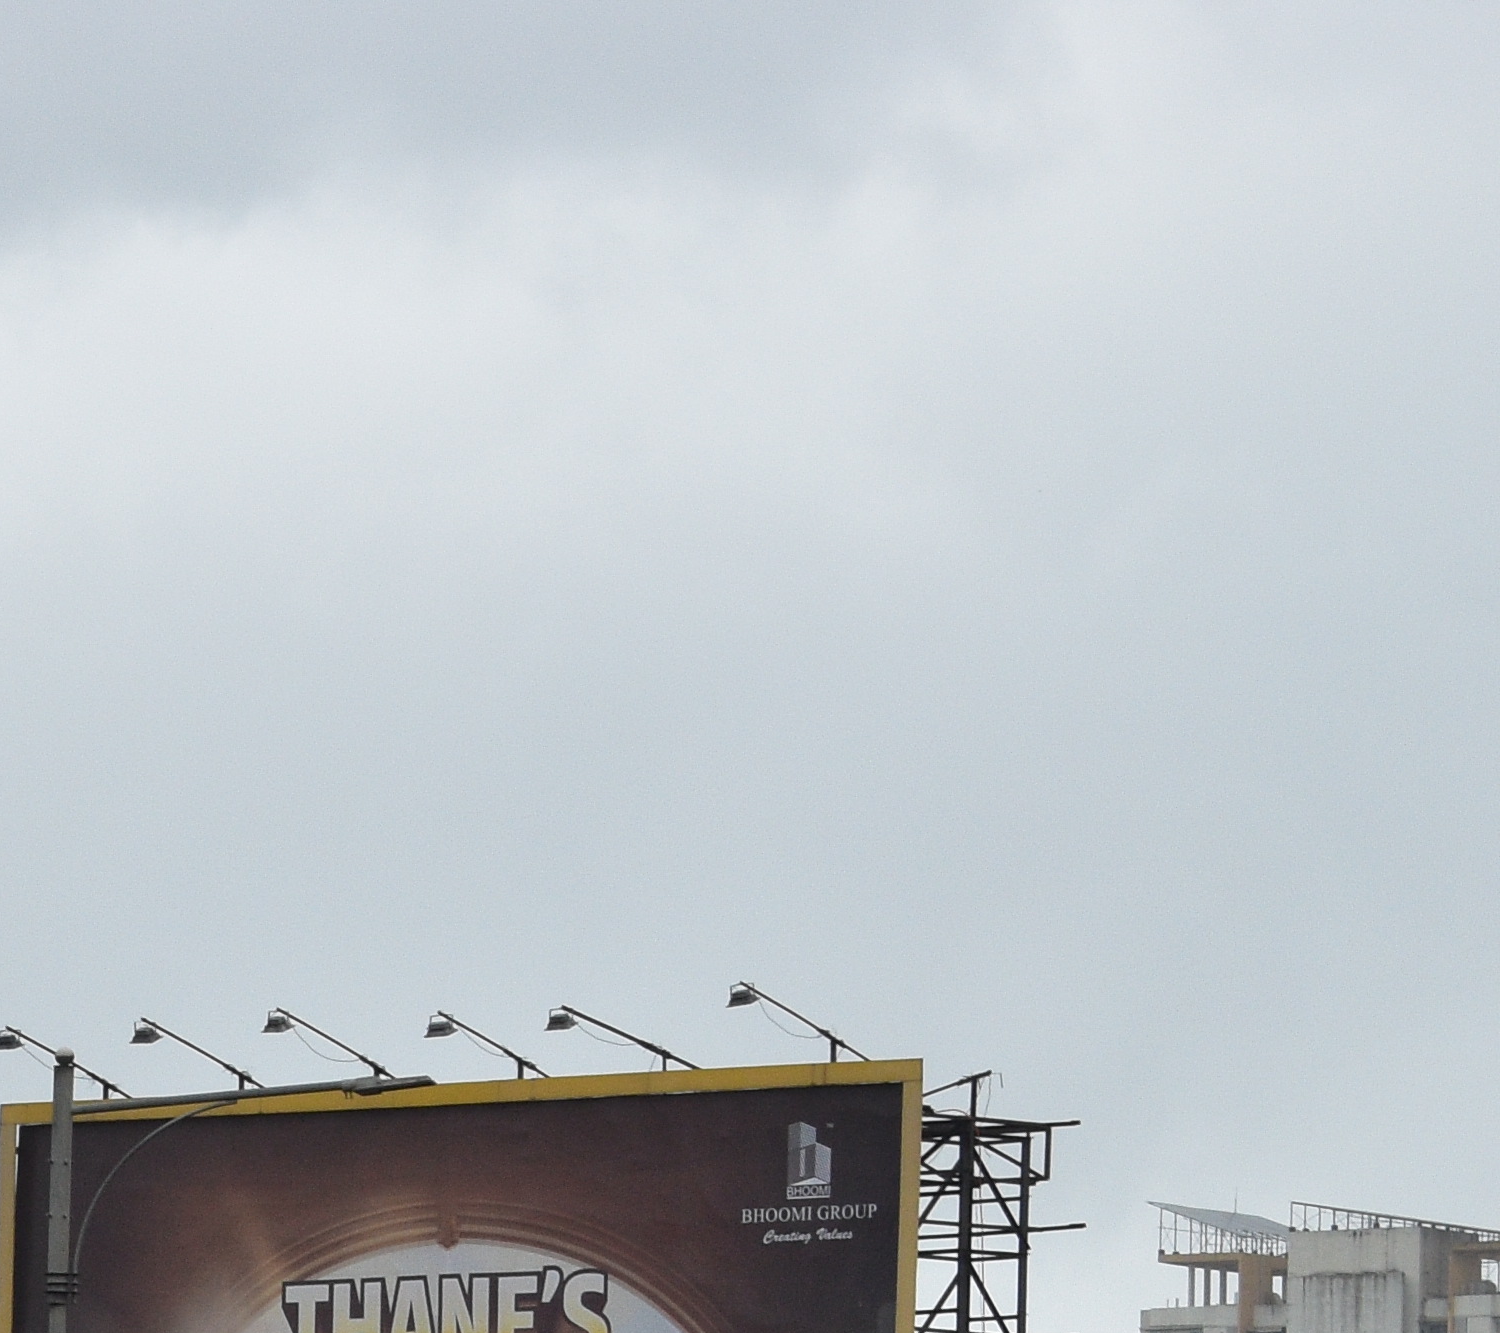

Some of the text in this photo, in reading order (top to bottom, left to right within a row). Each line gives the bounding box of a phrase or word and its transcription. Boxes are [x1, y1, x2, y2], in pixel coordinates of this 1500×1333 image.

[787, 1186, 831, 1197] BHOOMI
[741, 1203, 877, 1224] BHOOMI GROUP
[762, 1227, 853, 1244] Creating Values
